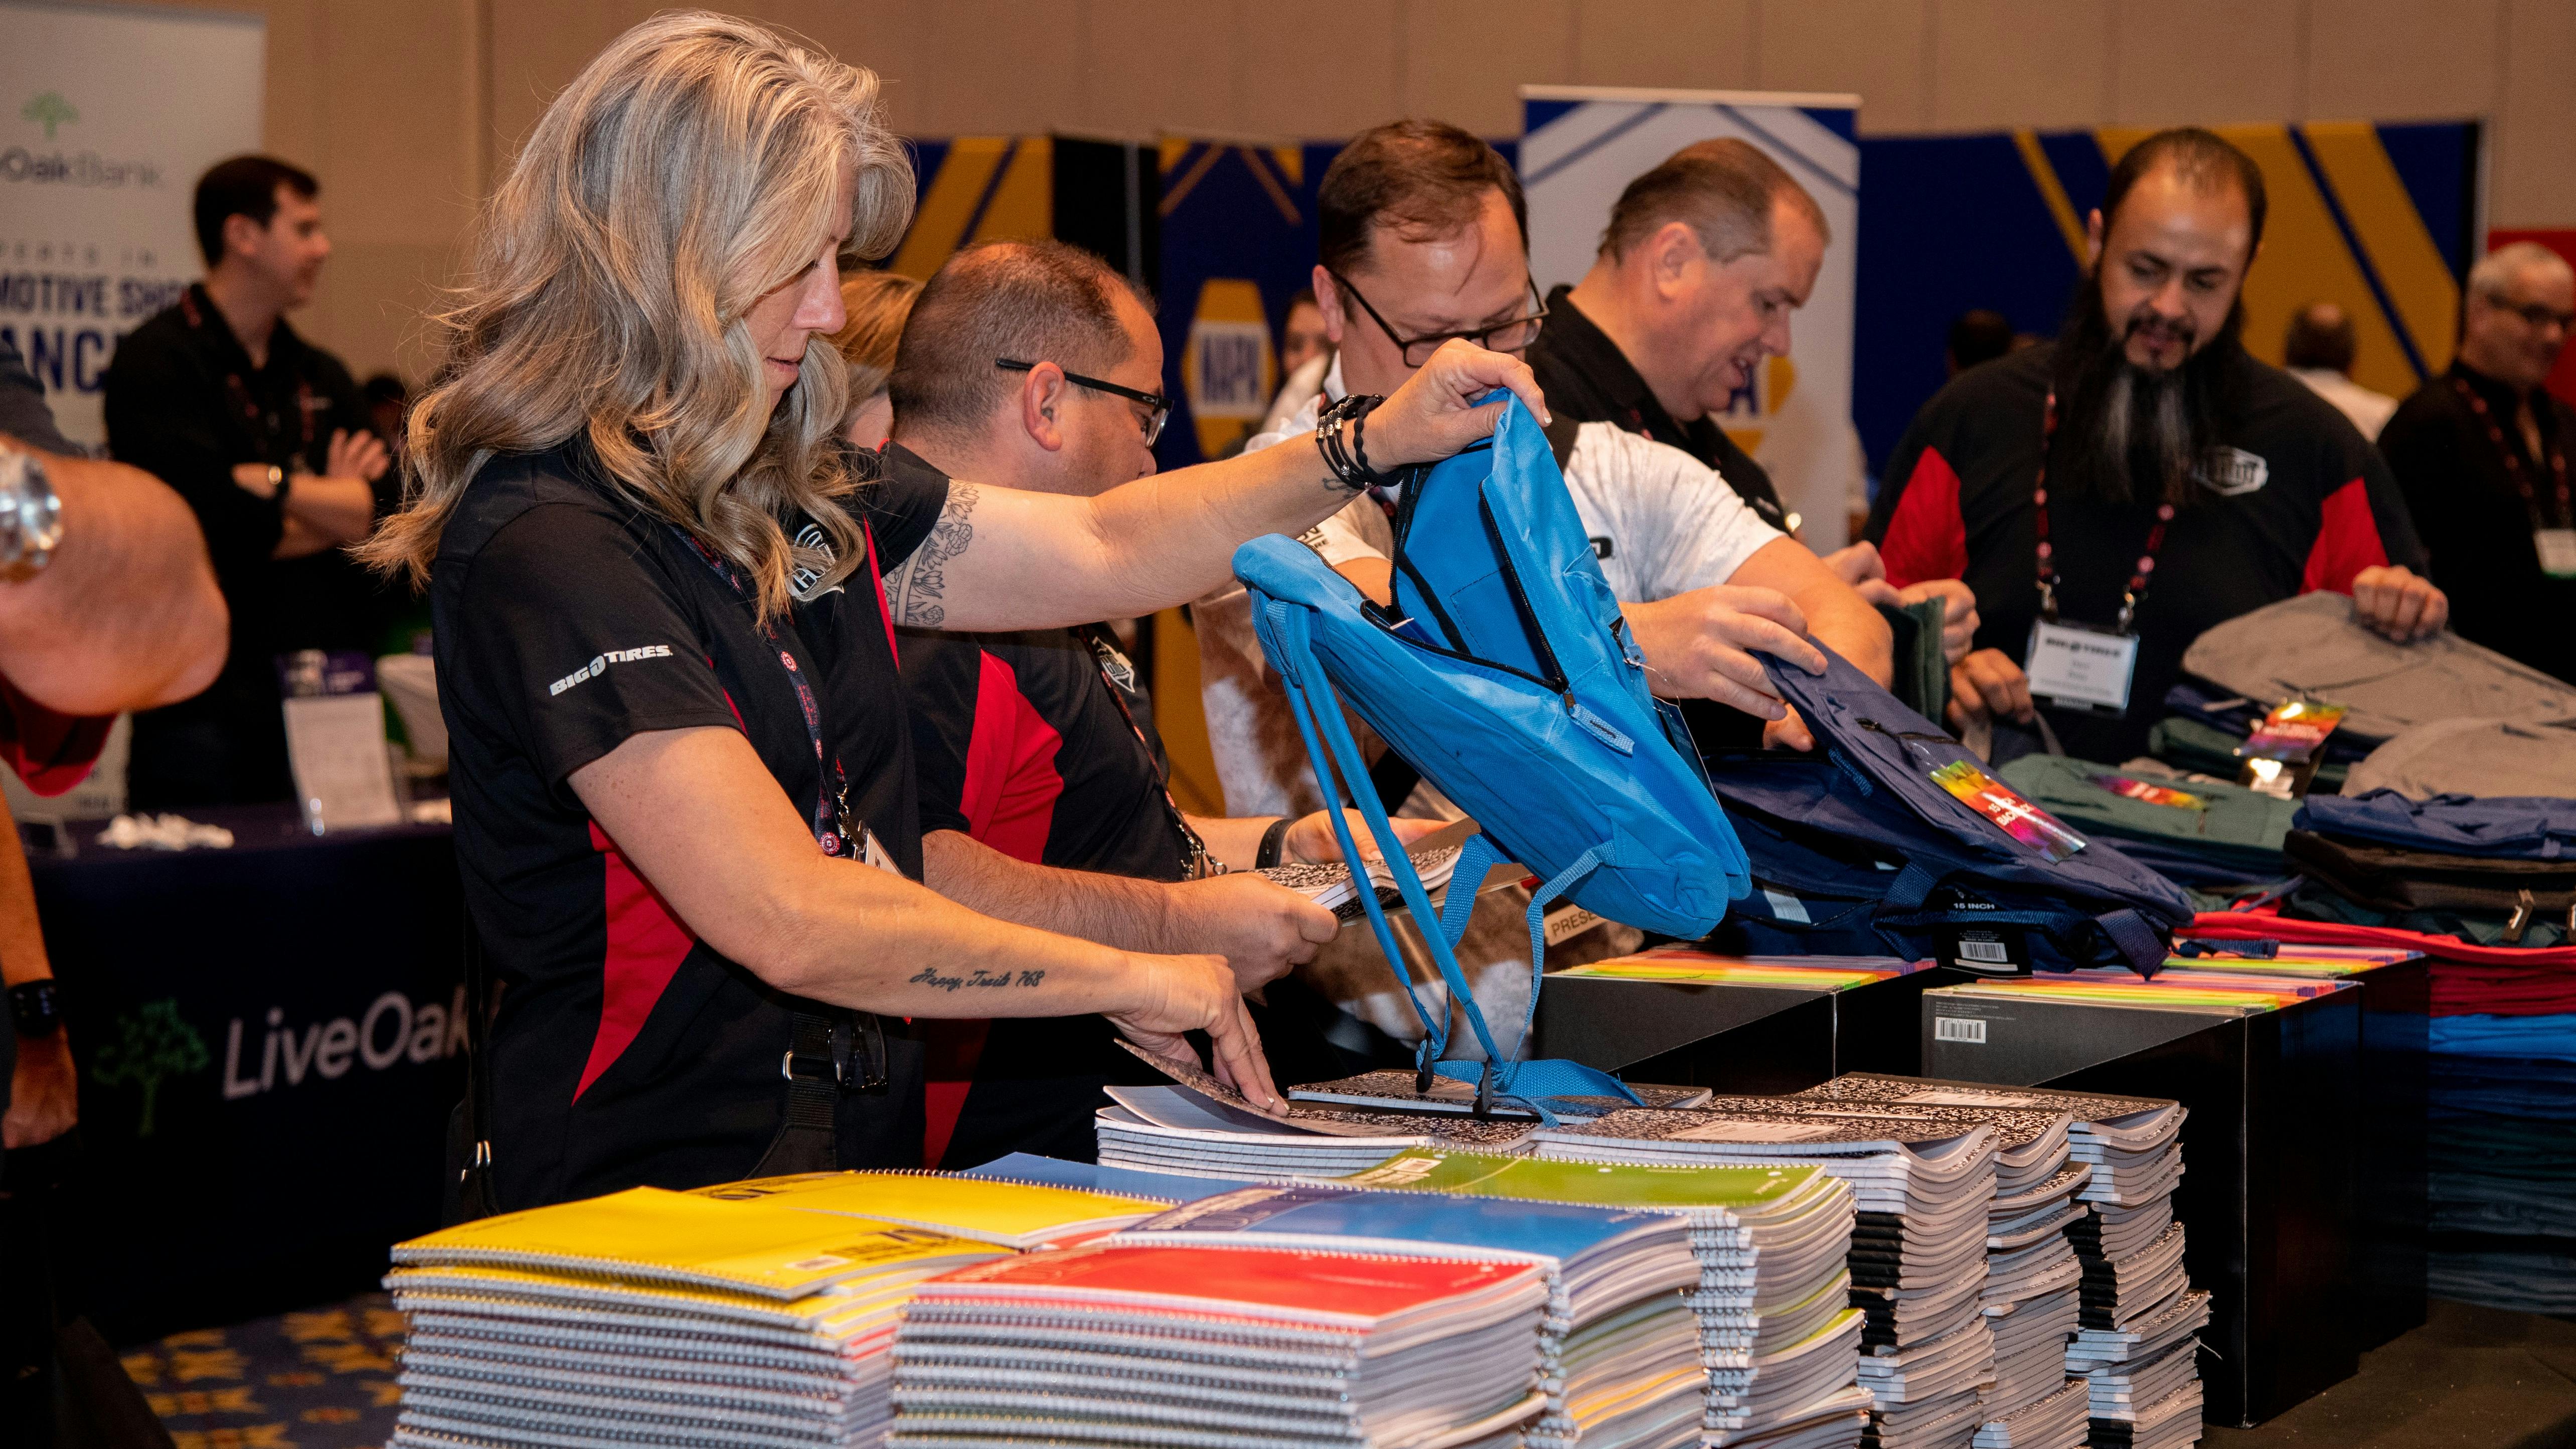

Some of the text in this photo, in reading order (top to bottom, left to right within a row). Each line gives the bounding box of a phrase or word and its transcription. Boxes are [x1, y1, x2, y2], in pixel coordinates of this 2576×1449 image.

[0, 325, 120, 394] NC
[550, 667, 590, 696] BIG
[589, 655, 606, 677] O
